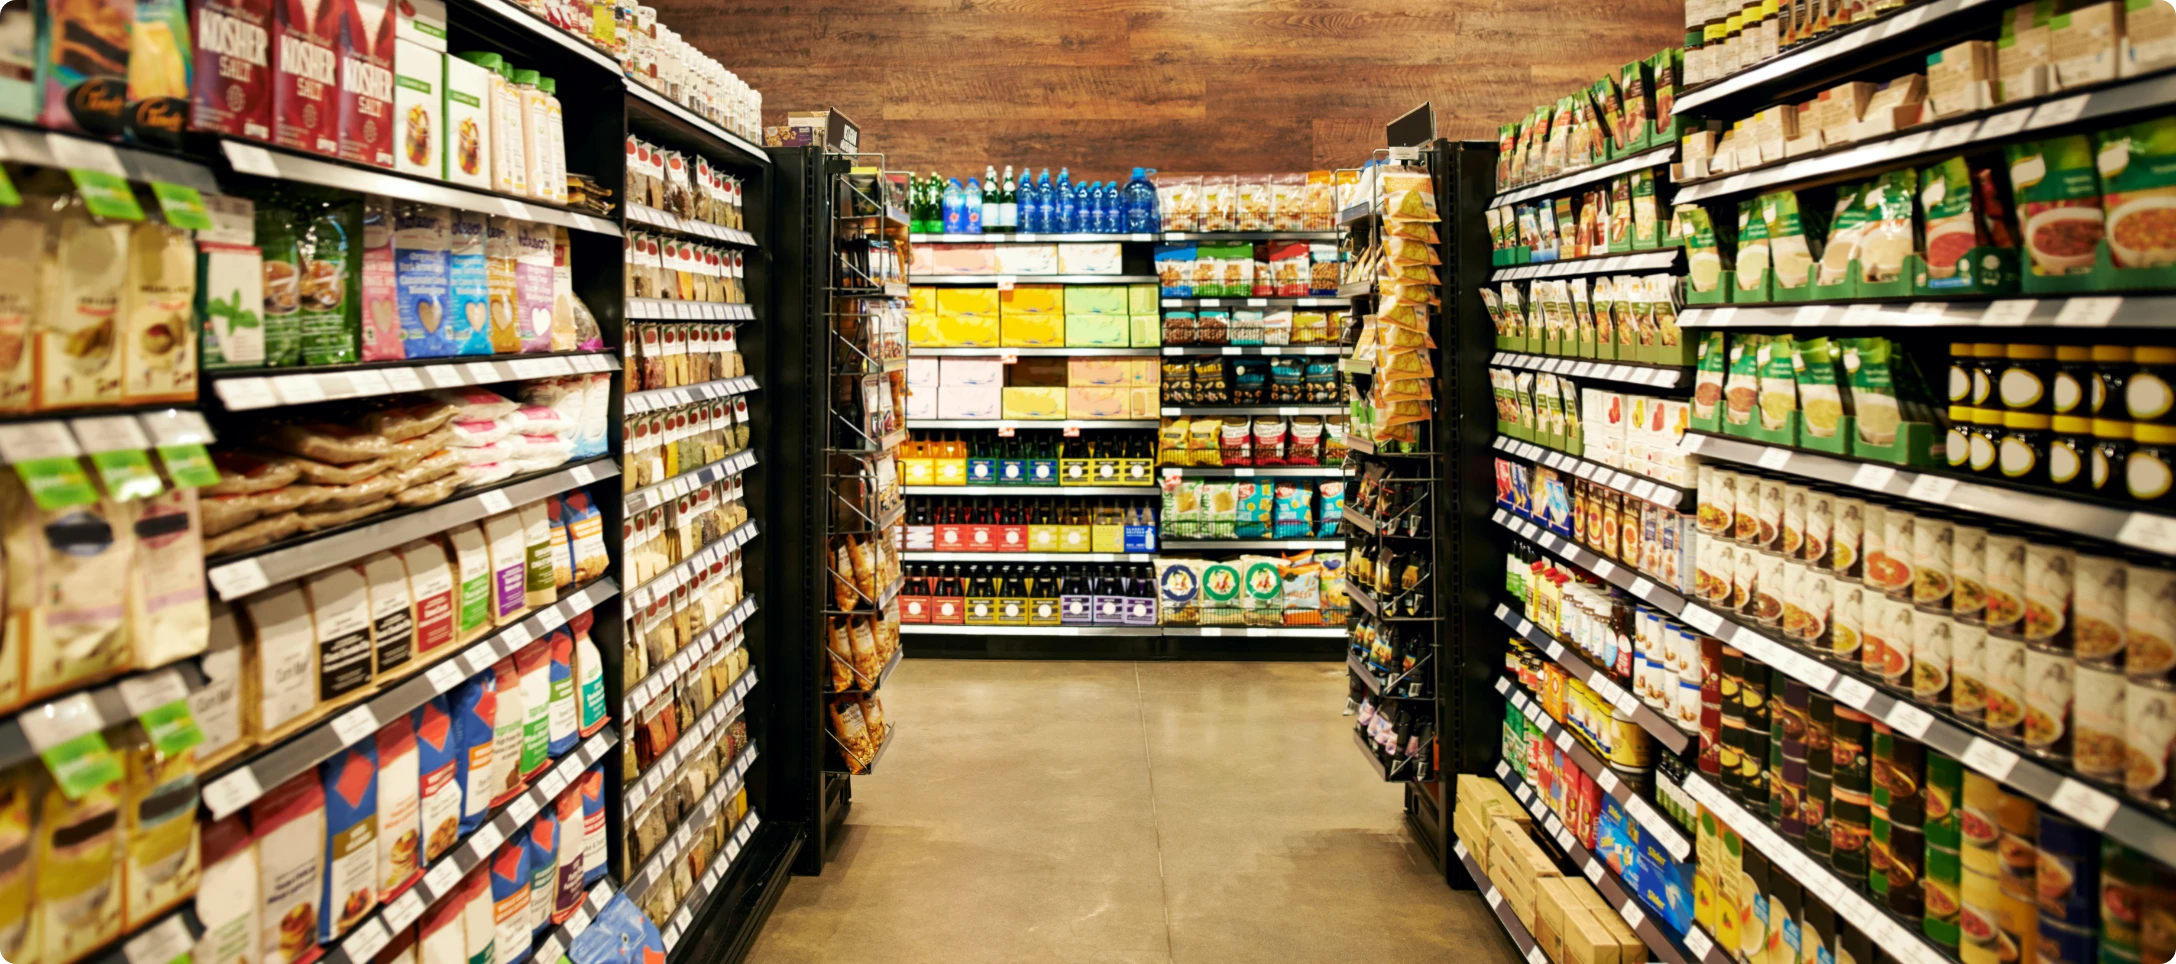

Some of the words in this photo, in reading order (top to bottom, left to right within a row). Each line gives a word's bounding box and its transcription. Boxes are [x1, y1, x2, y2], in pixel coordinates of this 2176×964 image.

[219, 56, 252, 82] SALT
[296, 78, 324, 101] SALT
[358, 96, 383, 118] SALT
